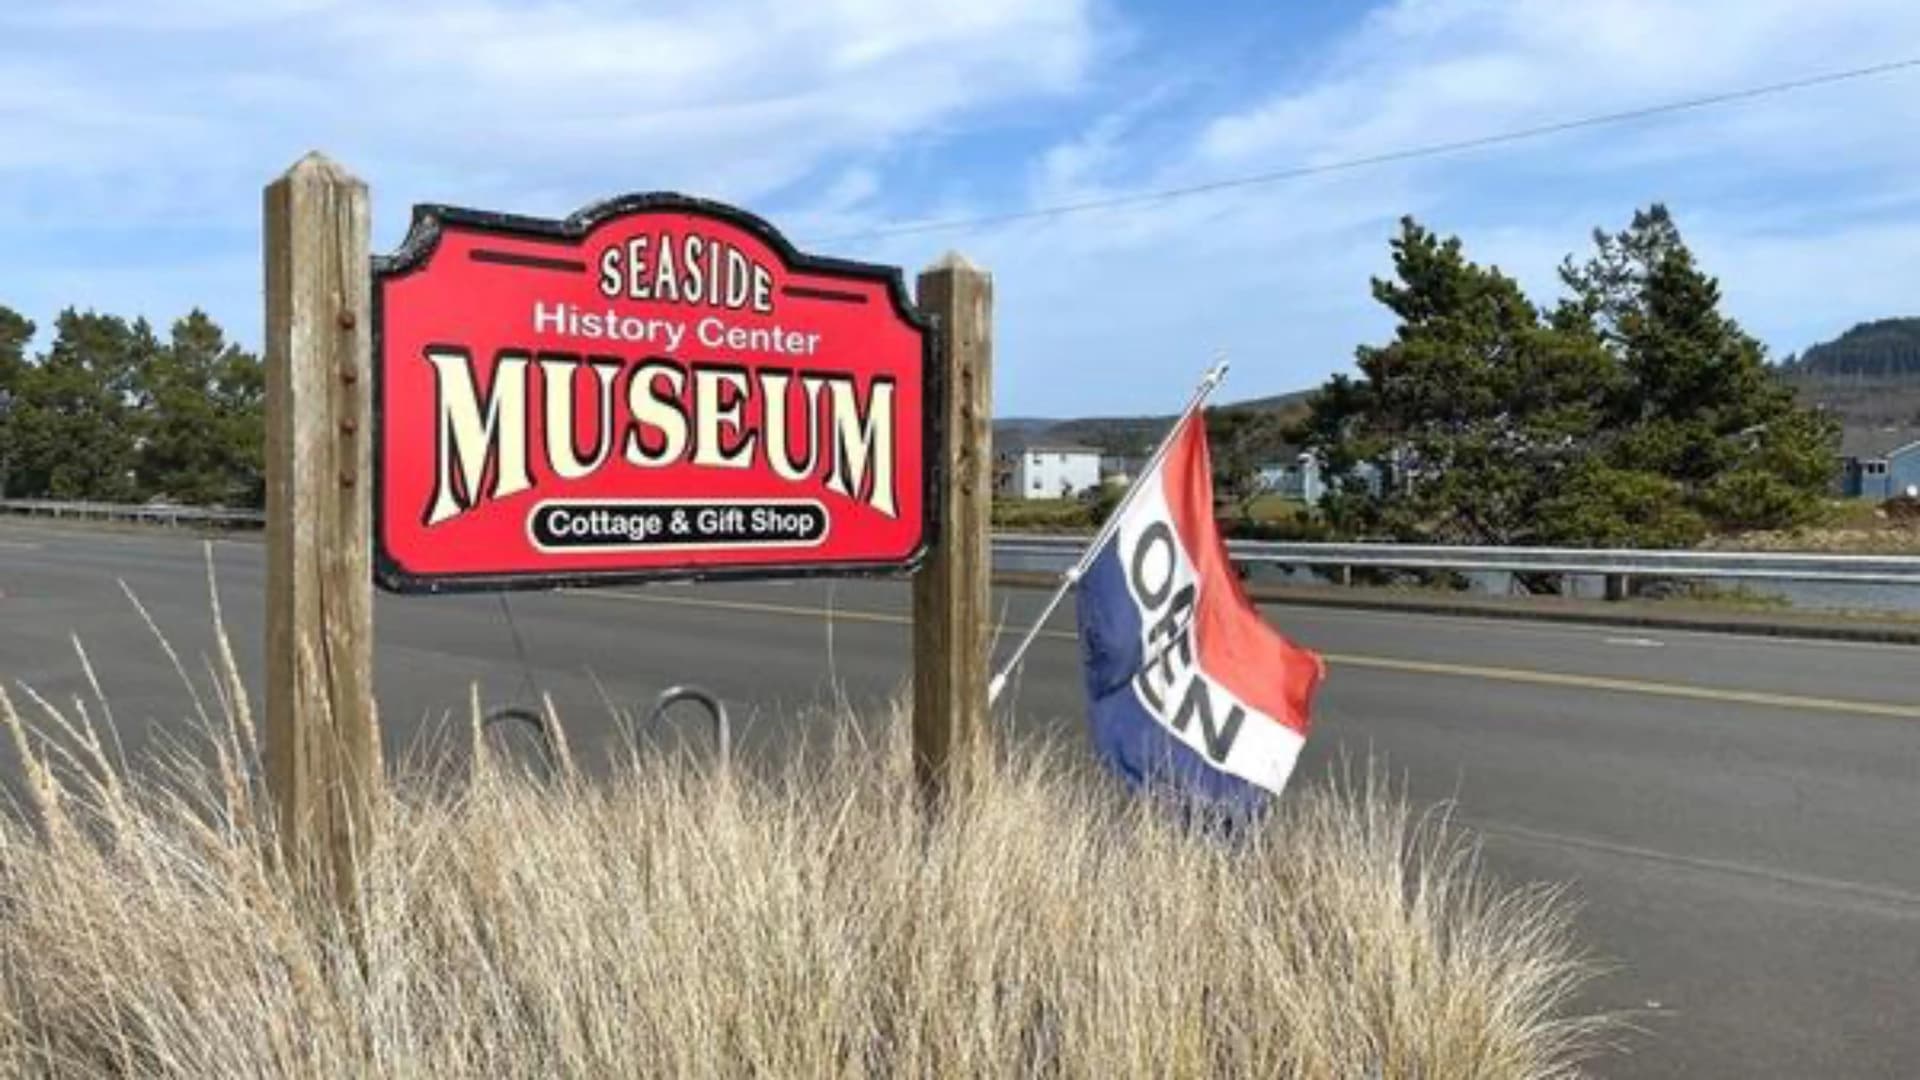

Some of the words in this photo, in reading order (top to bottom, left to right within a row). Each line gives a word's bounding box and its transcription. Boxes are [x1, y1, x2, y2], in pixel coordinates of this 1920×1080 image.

[599, 233, 773, 312] SEASIDE
[533, 302, 685, 351] History
[697, 317, 821, 355] Center
[423, 345, 899, 528] MUSEUM
[546, 509, 662, 540] Cottage
[670, 510, 691, 535] &
[697, 508, 747, 534] Gift
[751, 507, 815, 537] Shop
